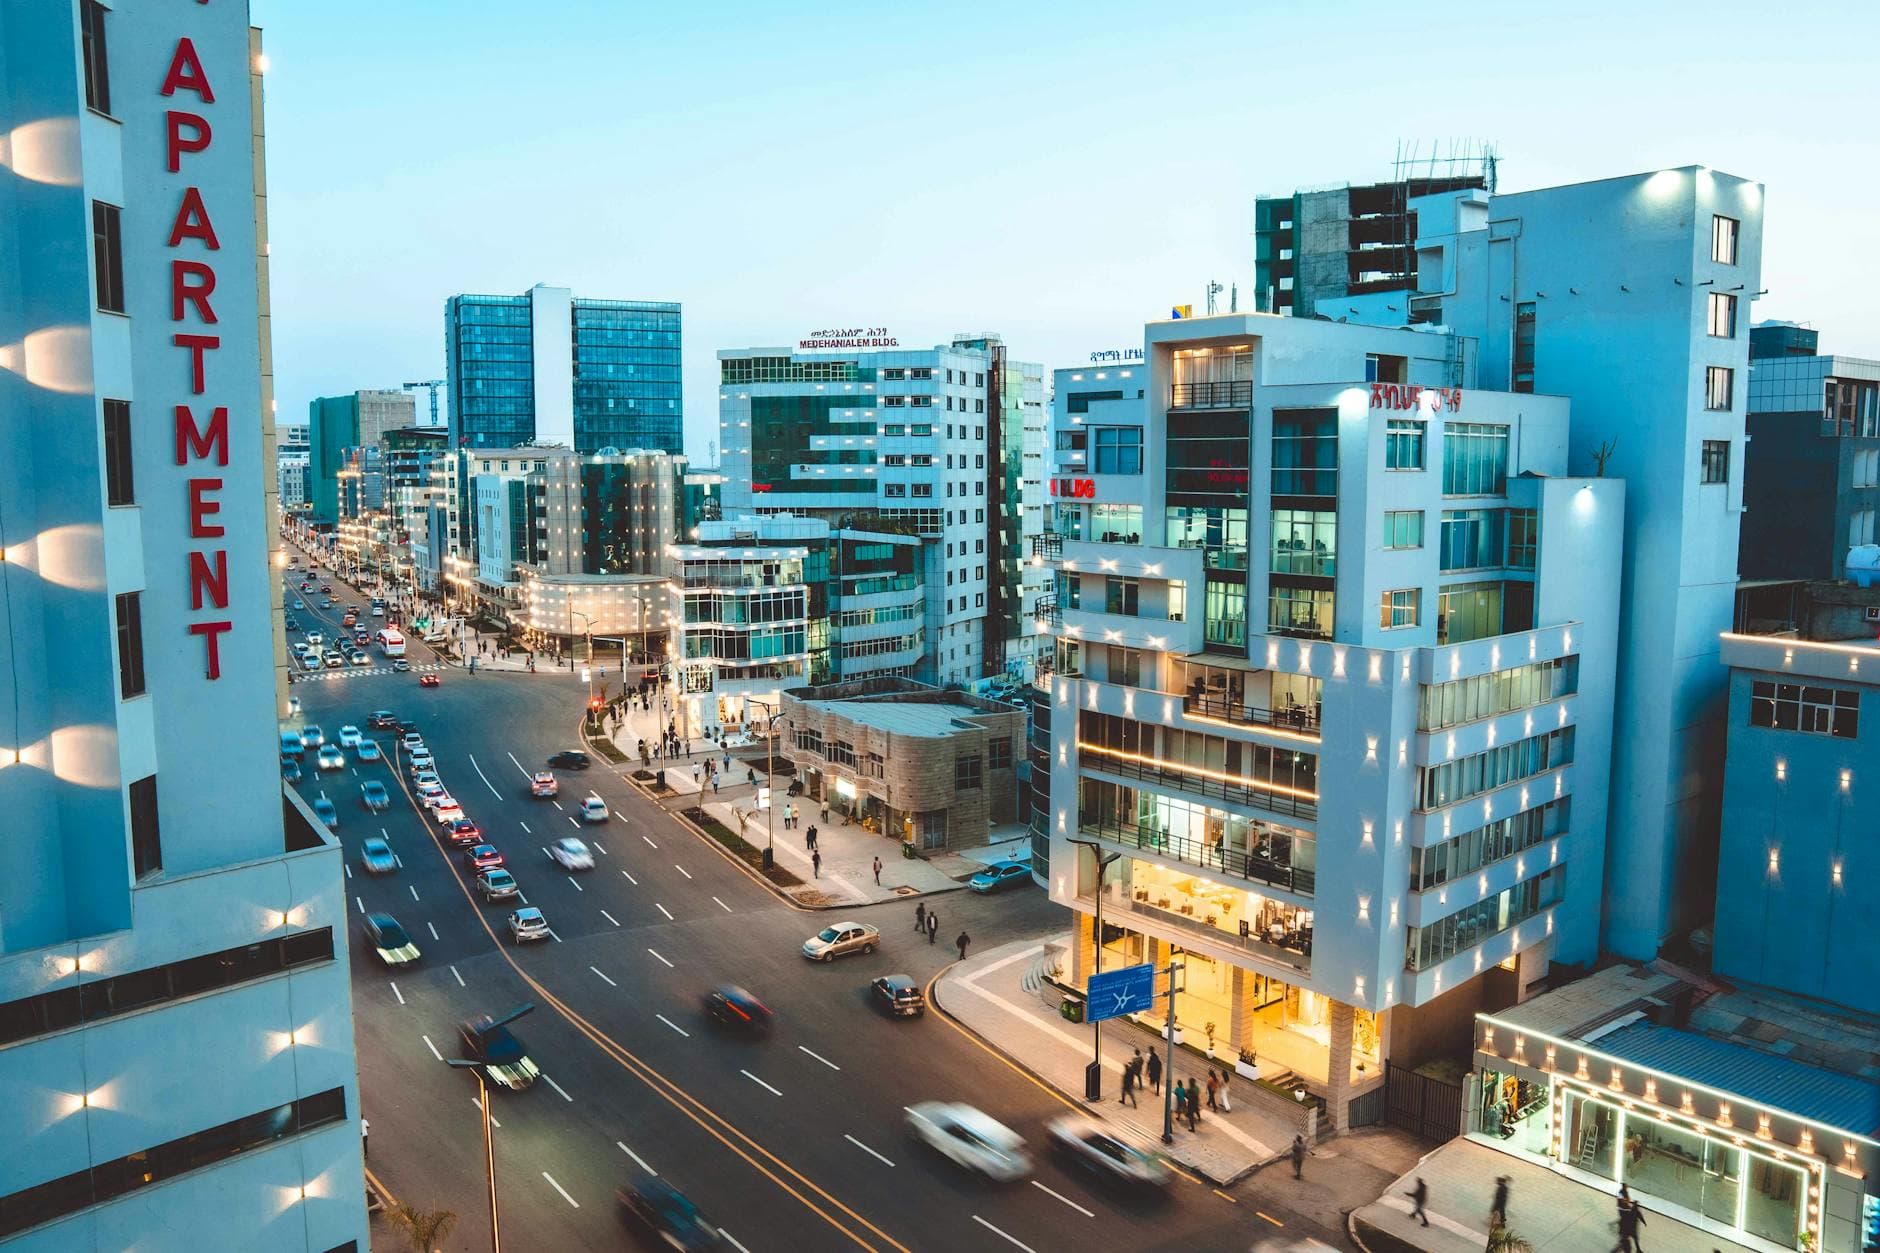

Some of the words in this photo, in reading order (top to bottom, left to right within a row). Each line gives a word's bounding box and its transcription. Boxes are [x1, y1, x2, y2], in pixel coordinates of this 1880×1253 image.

[160, 36, 233, 681] APARTMENT
[799, 338, 870, 348] MEDEHANIALEM
[872, 337, 900, 347] BLDG.
